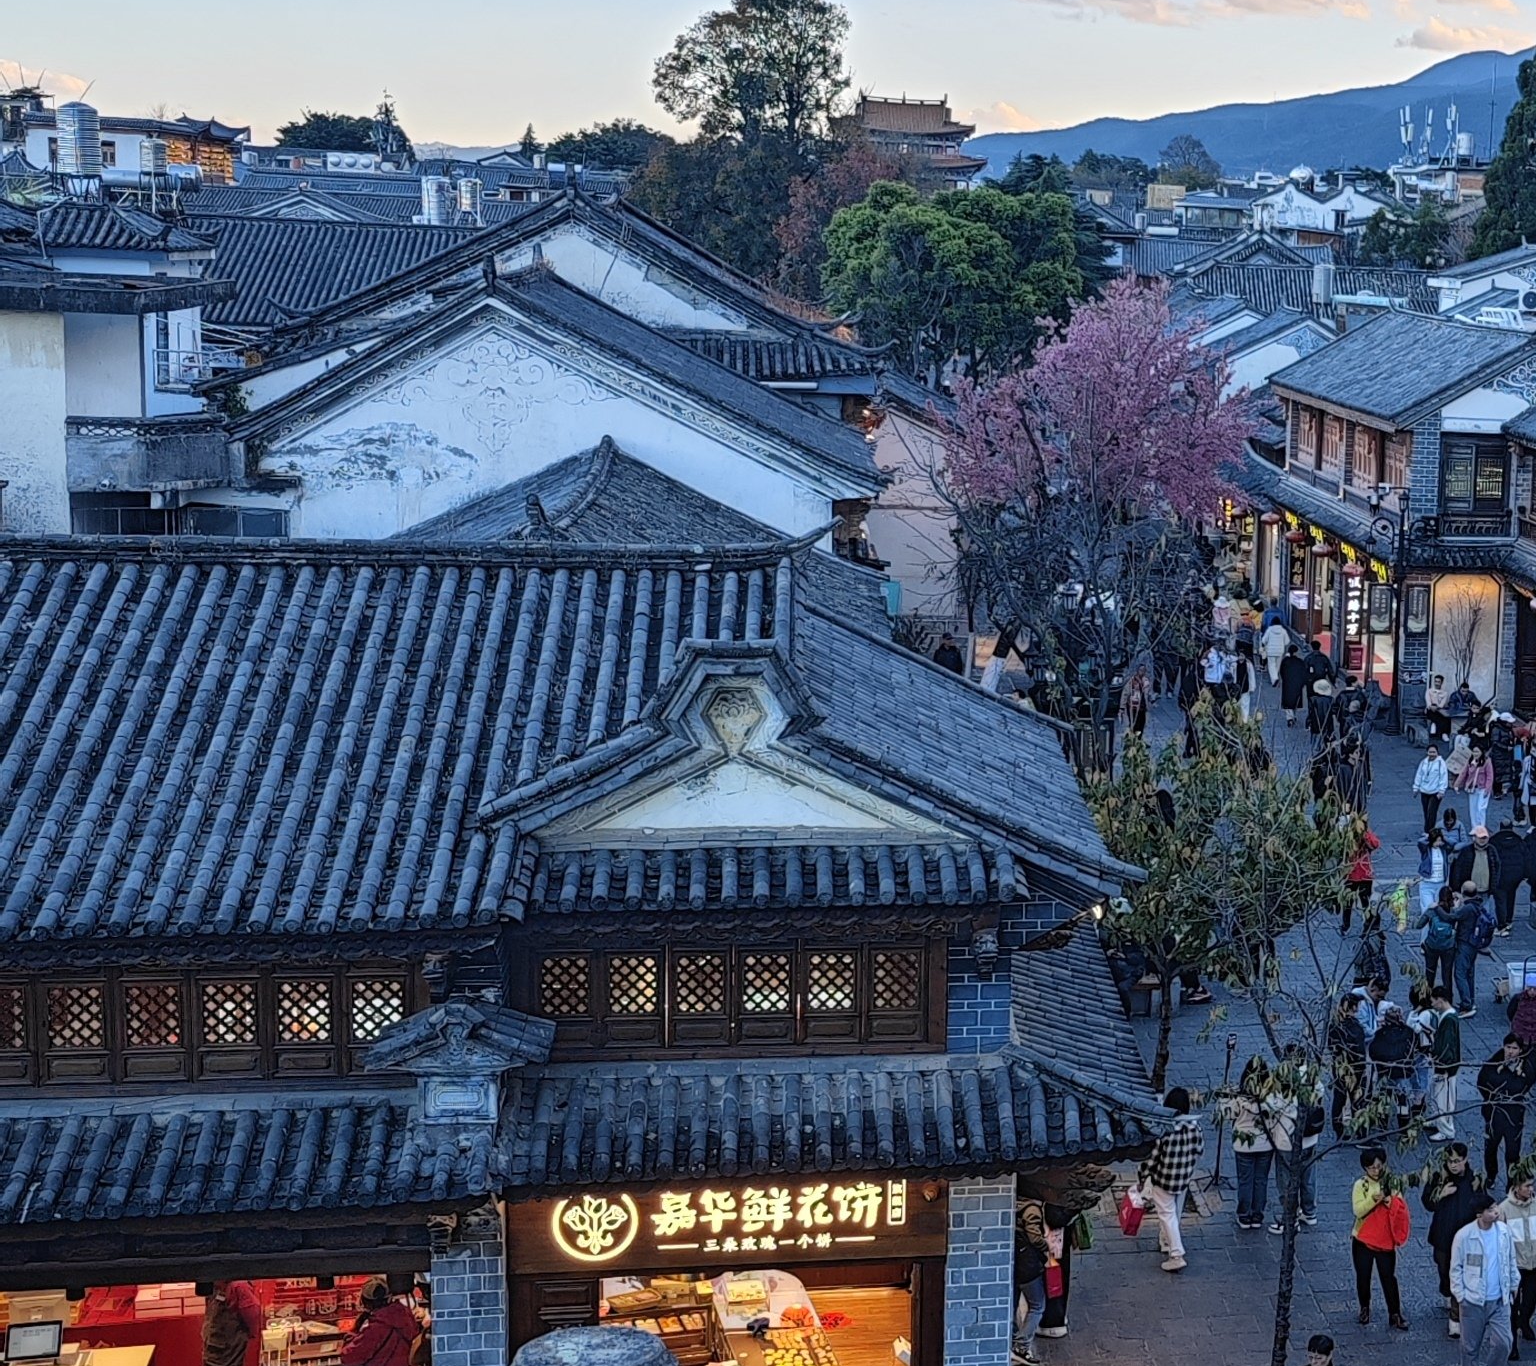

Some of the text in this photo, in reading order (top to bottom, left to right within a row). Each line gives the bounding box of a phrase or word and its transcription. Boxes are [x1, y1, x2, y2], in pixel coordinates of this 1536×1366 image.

[651, 1182, 883, 1235] 嘉华鲜花饼
[702, 1234, 833, 1253] 三朵玫瑰一个饼
